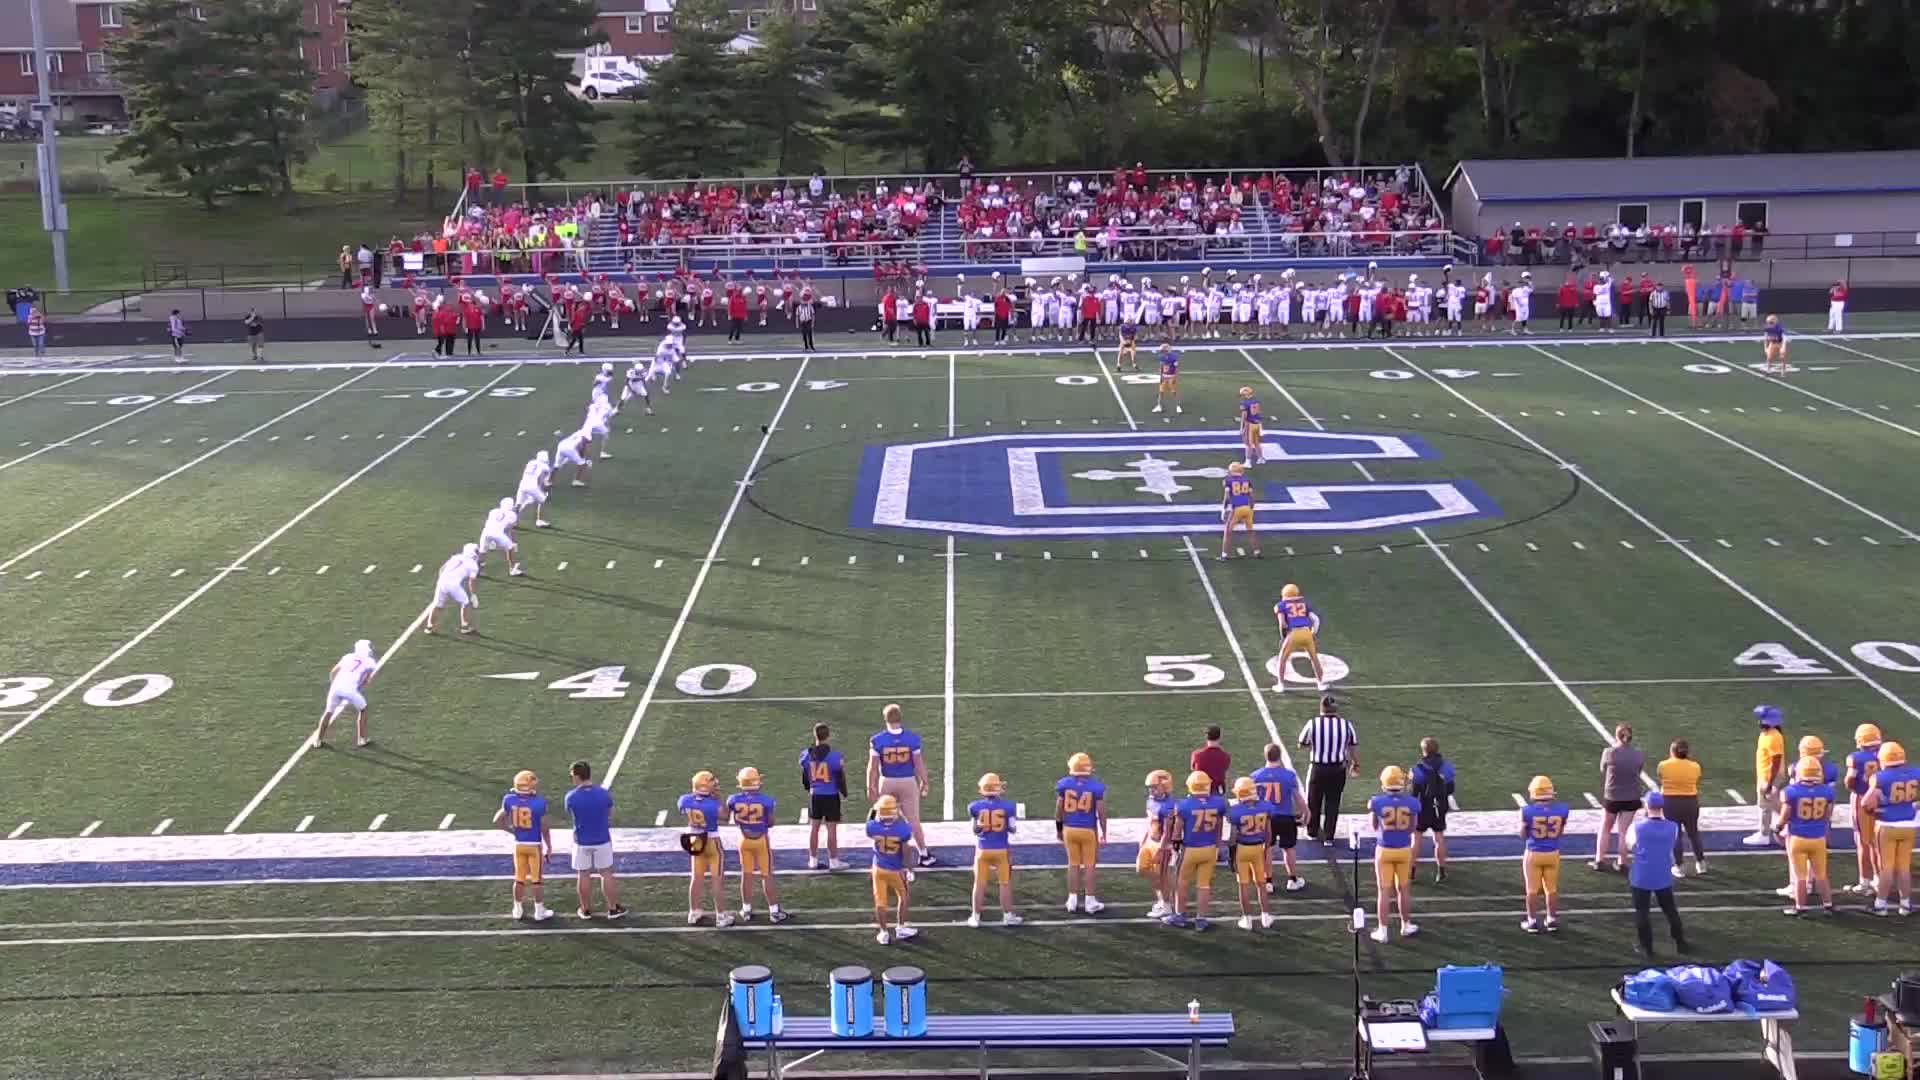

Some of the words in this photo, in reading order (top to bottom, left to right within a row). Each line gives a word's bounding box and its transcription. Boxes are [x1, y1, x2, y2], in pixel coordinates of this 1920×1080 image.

[1231, 480, 1249, 496] 84
[1285, 602, 1307, 617] 32
[350, 659, 362, 672] 7
[882, 746, 911, 764] 55
[809, 761, 831, 783] 14
[1064, 789, 1093, 812] 64
[1256, 782, 1281, 804] 71
[1889, 779, 1919, 804] 66
[511, 805, 532, 829] 18
[734, 802, 763, 824] 22
[1191, 808, 1218, 832] 75
[1382, 805, 1410, 830] 26
[1798, 797, 1827, 820] 68
[1240, 812, 1267, 835] 28
[1533, 815, 1563, 839] 53
